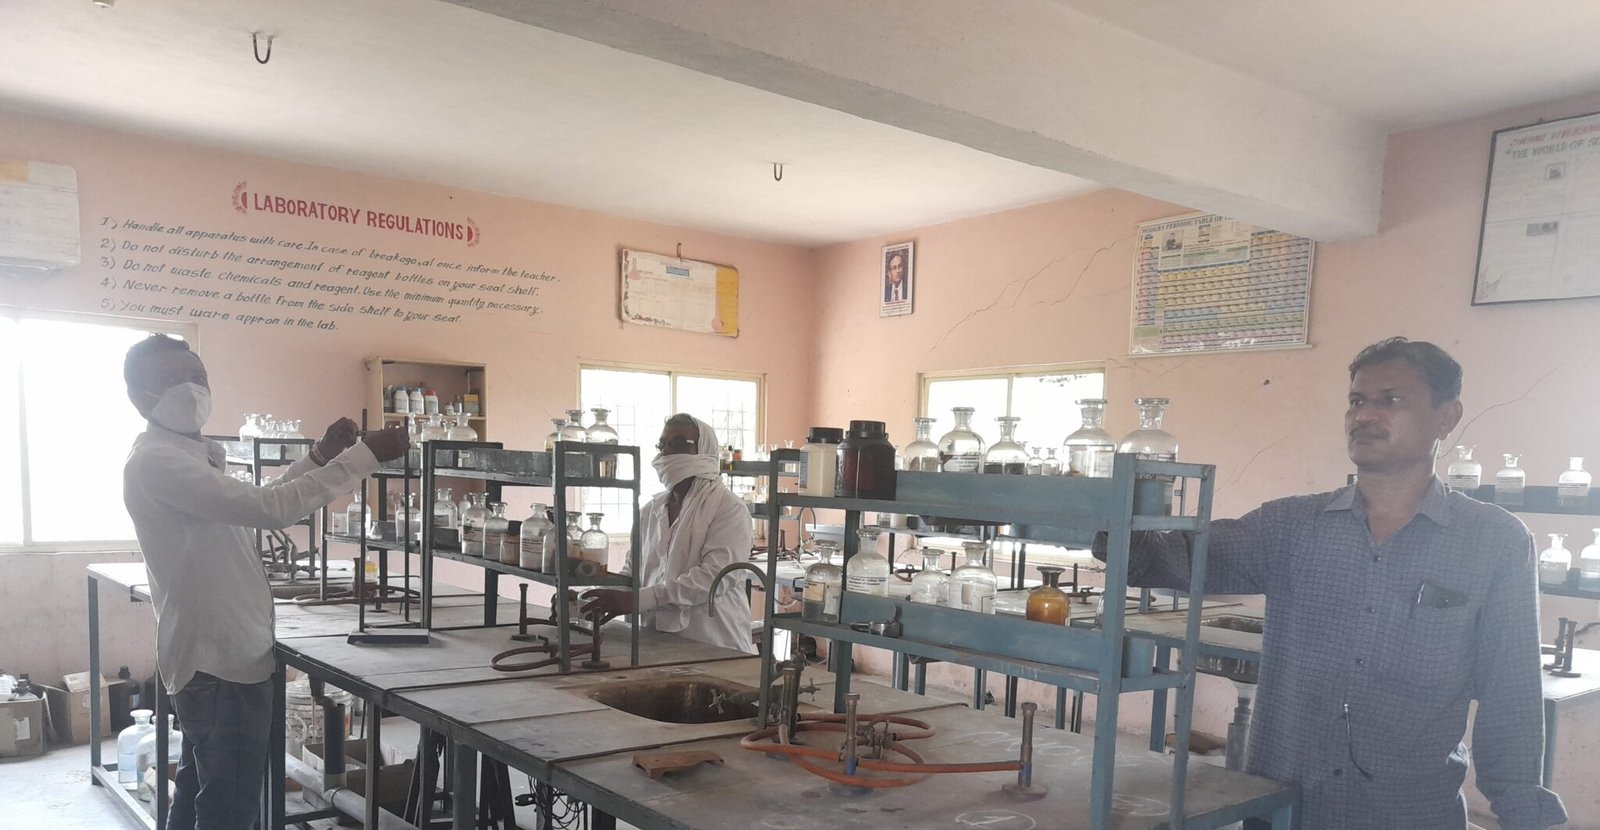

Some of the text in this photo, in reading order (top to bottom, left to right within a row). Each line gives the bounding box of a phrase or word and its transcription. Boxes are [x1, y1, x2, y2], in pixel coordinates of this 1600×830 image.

[253, 192, 464, 241] LABORATORY REGULATIONS
[100, 237, 116, 253] 2)
[121, 240, 139, 252] Do
[142, 244, 166, 254] not
[168, 246, 220, 260] disturb
[222, 251, 243, 263] the
[246, 255, 325, 271] arrangement
[328, 263, 345, 274] of
[345, 267, 391, 281] reagent
[394, 271, 434, 286] bottles
[437, 279, 451, 288] on
[449, 280, 477, 293] your
[479, 283, 506, 294] seat
[122, 219, 165, 234] Handle
[166, 226, 185, 235] all
[185, 230, 247, 242] apparatus
[249, 235, 275, 246] with
[320, 246, 348, 256] case
[351, 247, 367, 257] of
[436, 261, 462, 271] once
[466, 264, 500, 276] inform
[502, 267, 519, 278] the
[100, 256, 116, 271] 3)
[122, 259, 140, 272] Do
[142, 262, 166, 274] not
[170, 265, 213, 280] waste
[217, 271, 283, 288] chemicals
[287, 280, 313, 291] and
[384, 288, 401, 300] the
[403, 292, 445, 304] minimum
[447, 297, 486, 312] quantity
[122, 279, 168, 294] Never
[171, 285, 221, 300] remove
[223, 292, 233, 301] a
[235, 291, 272, 306] bottle
[307, 299, 326, 312] the
[328, 302, 355, 314] side
[359, 304, 393, 318] shelf
[393, 308, 405, 319] to
[402, 311, 432, 323] your
[120, 299, 147, 313] You
[149, 304, 185, 317] must
[188, 308, 231, 322] ware
[282, 316, 296, 326] in
[296, 318, 315, 330] the
